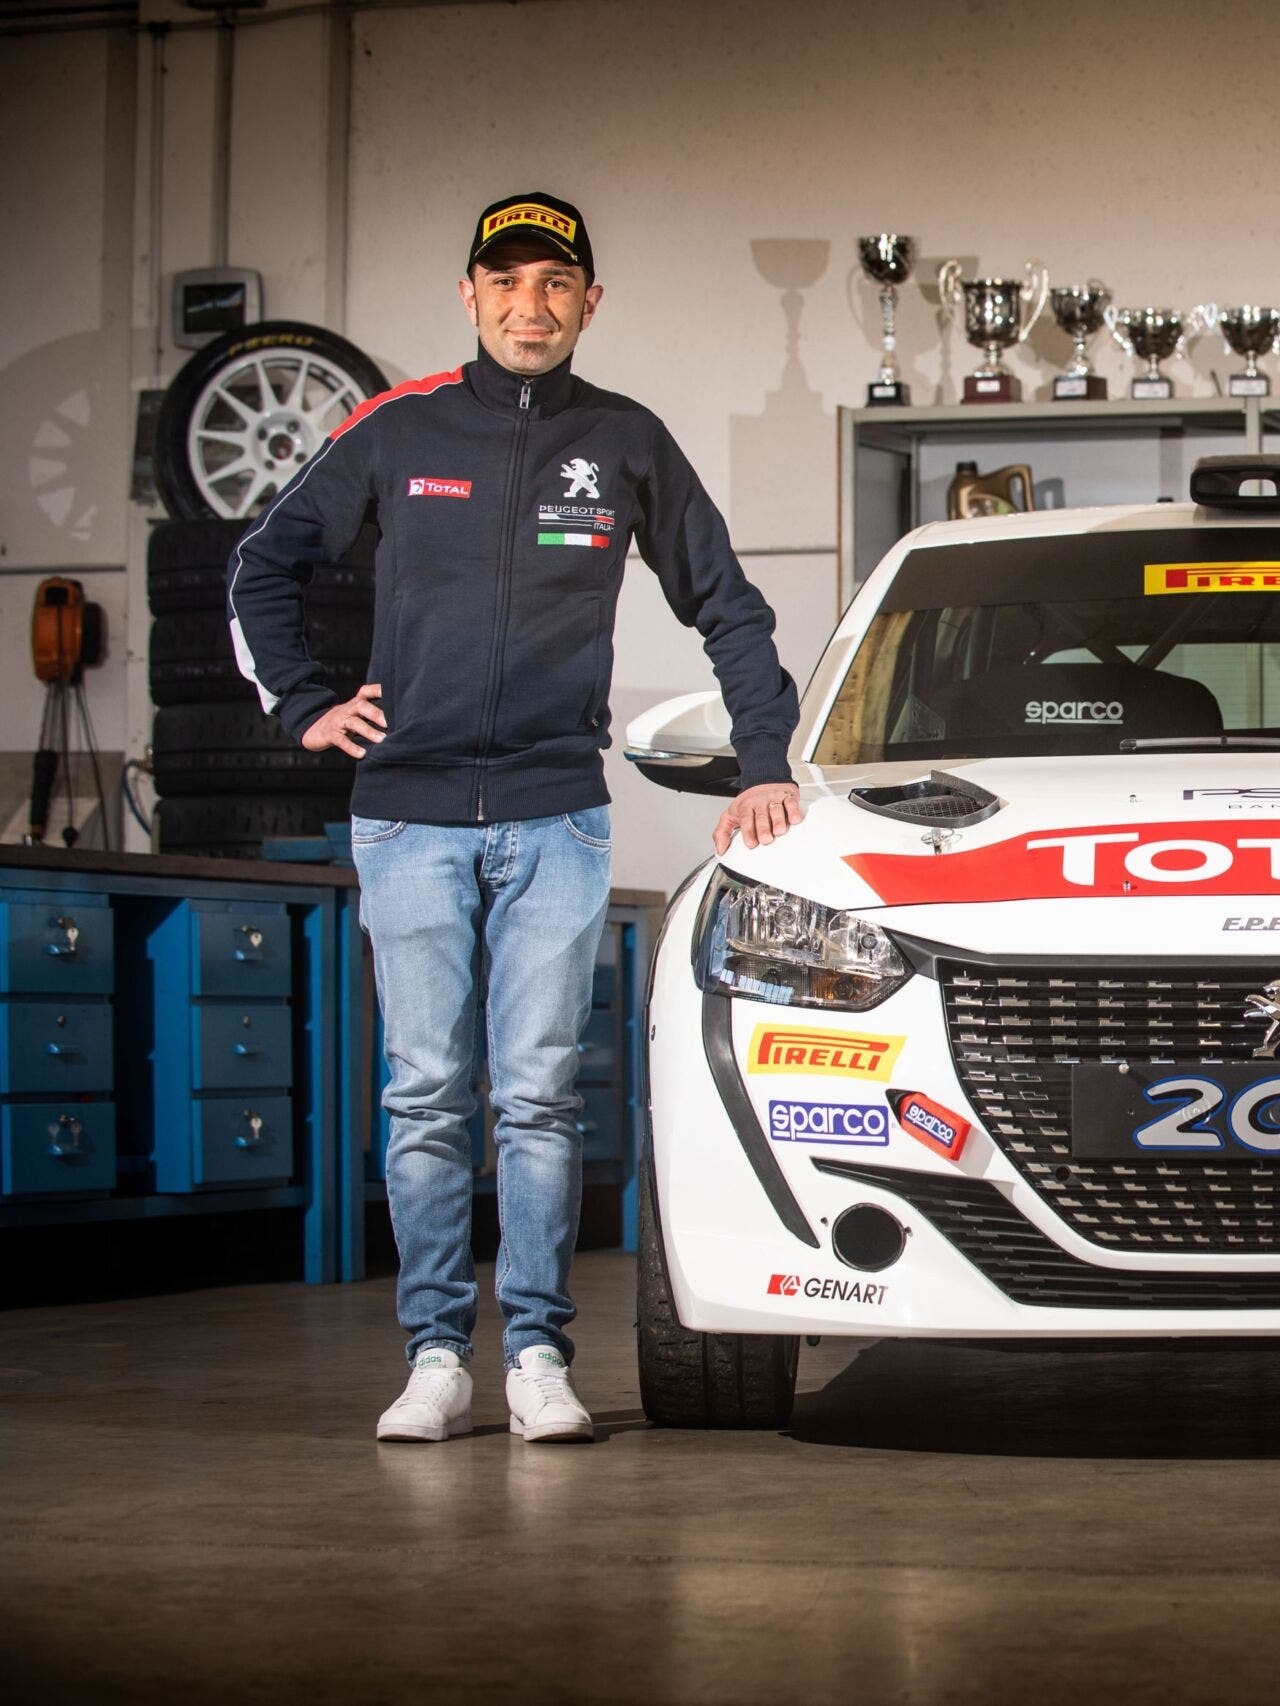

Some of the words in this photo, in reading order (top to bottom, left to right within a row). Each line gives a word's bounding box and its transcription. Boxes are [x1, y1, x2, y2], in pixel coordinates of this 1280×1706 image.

[489, 206, 571, 235] PIRELLI
[539, 505, 594, 515] PEUGEOT
[596, 507, 615, 516] SPORT
[1024, 701, 1124, 724] sparco
[758, 1032, 889, 1071] PIRELLI
[772, 1104, 886, 1142] sparco
[906, 1103, 954, 1144] sparco
[804, 1278, 889, 1305] GENART
